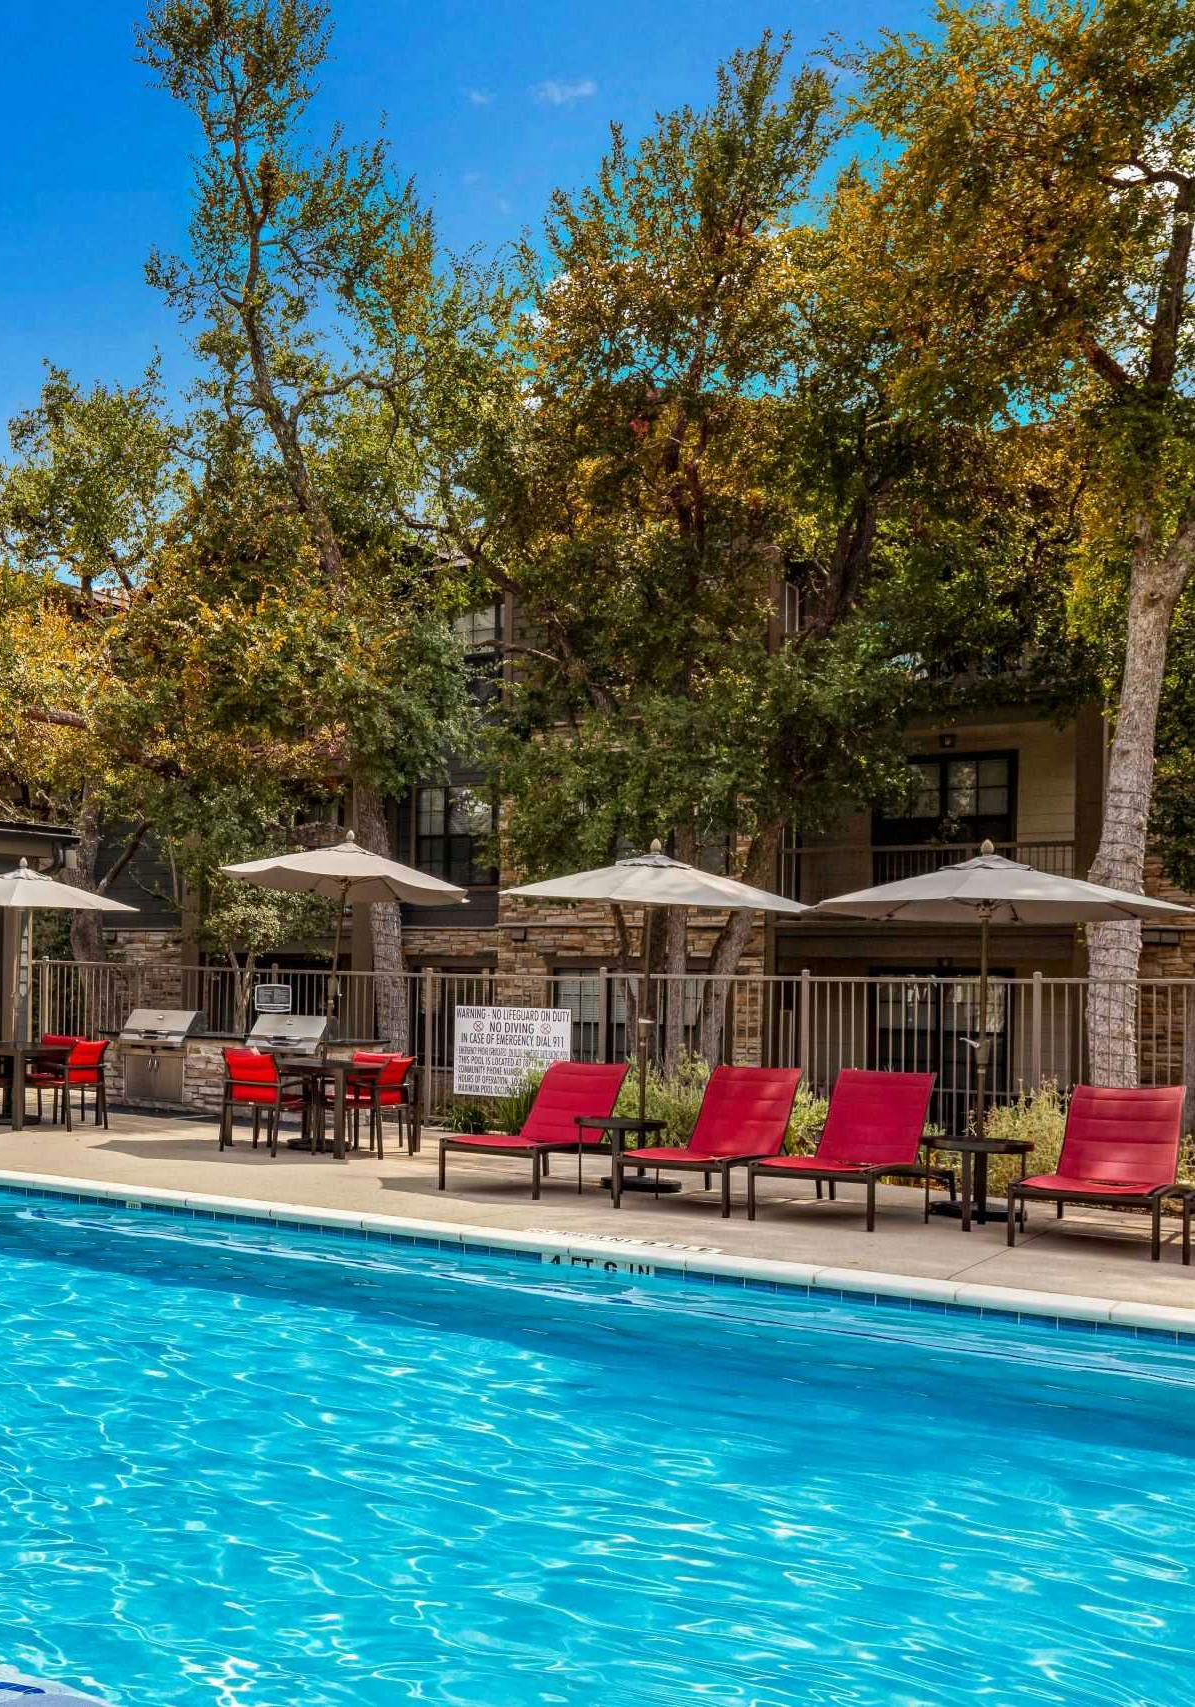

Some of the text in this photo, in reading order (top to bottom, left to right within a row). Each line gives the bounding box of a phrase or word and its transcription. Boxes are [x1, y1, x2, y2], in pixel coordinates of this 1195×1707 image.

[457, 1008, 485, 1019] WARNING
[492, 1009, 502, 1020] NO
[504, 1009, 539, 1021] LIFEGUARD
[541, 1010, 550, 1022] ON
[553, 1011, 569, 1022] DUTY
[490, 1021, 534, 1034] NO DIVING
[461, 1032, 468, 1043] IN
[470, 1032, 485, 1044] CASE
[486, 1033, 495, 1045] OF
[536, 1035, 552, 1047] DIAL
[553, 1036, 564, 1048] 911
[471, 1056, 485, 1065] POOL
[492, 1057, 515, 1067] LOCATED
